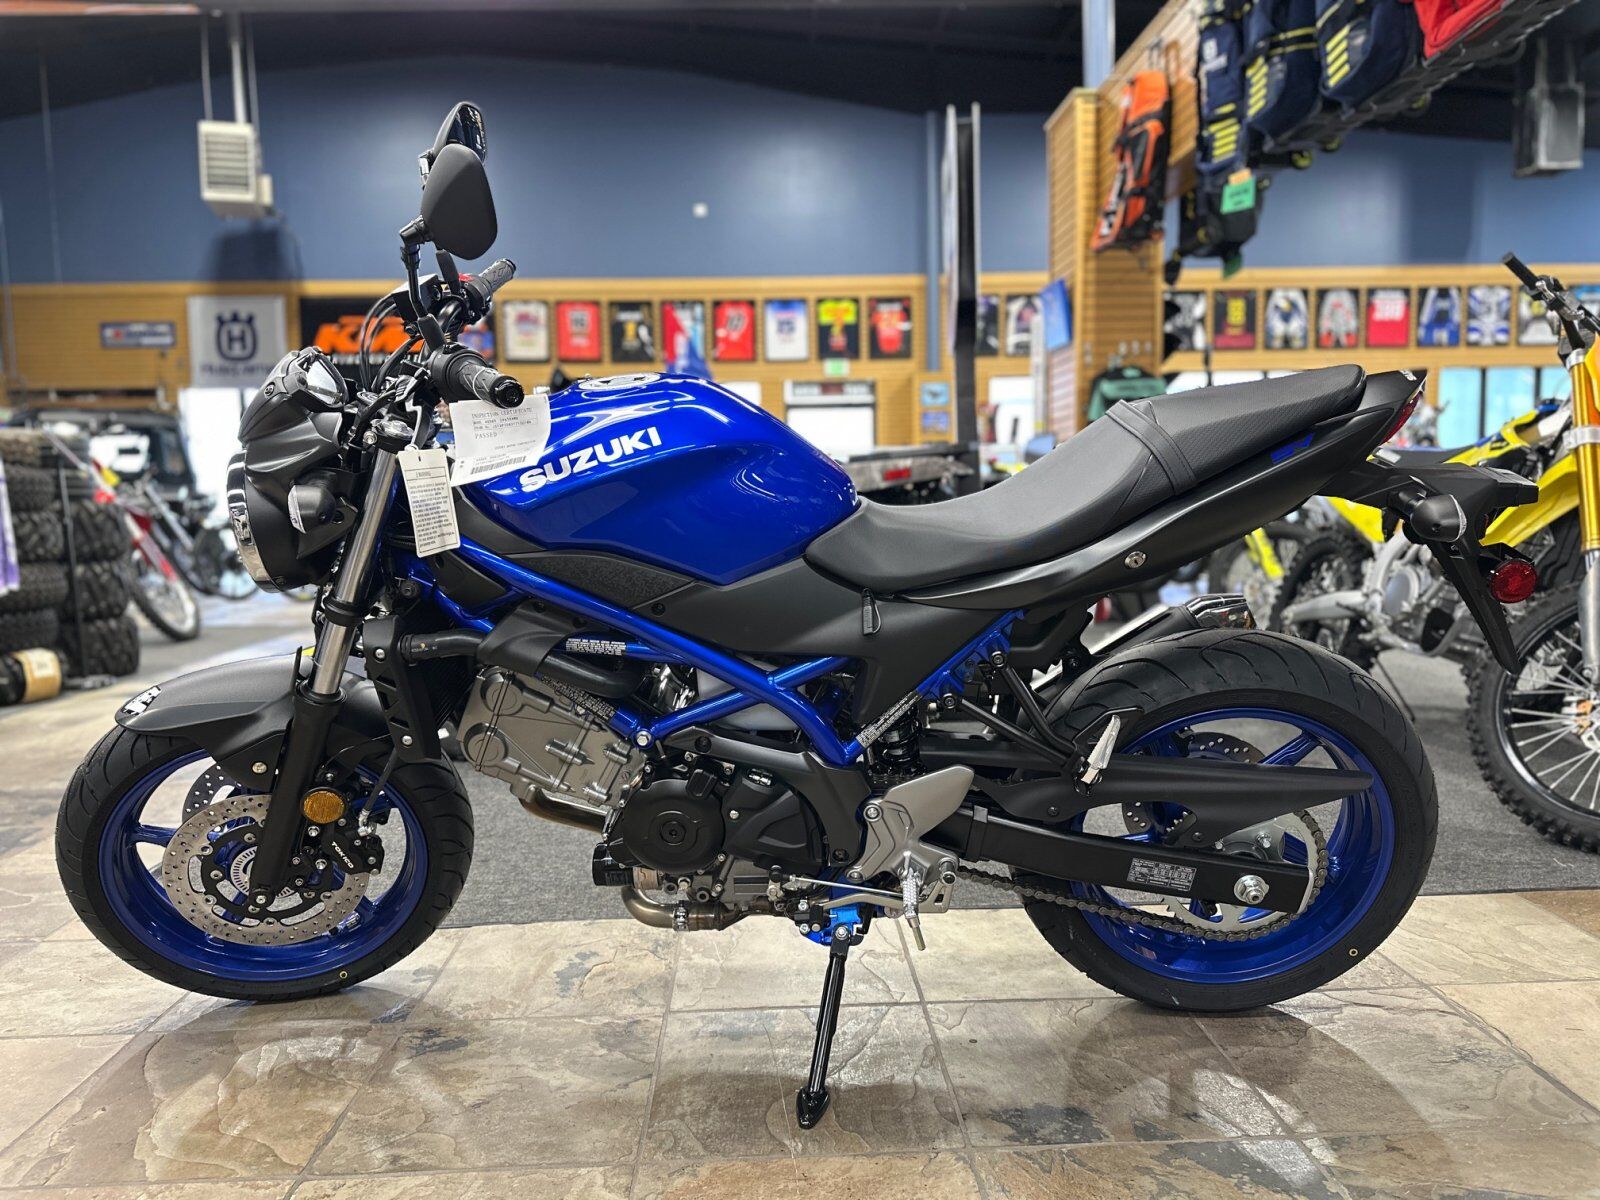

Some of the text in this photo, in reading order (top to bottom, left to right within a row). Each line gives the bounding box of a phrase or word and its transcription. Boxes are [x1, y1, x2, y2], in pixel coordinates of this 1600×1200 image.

[474, 432, 498, 440] PASSED
[519, 426, 663, 493] SUZUKI
[331, 841, 354, 869] TOKICO
